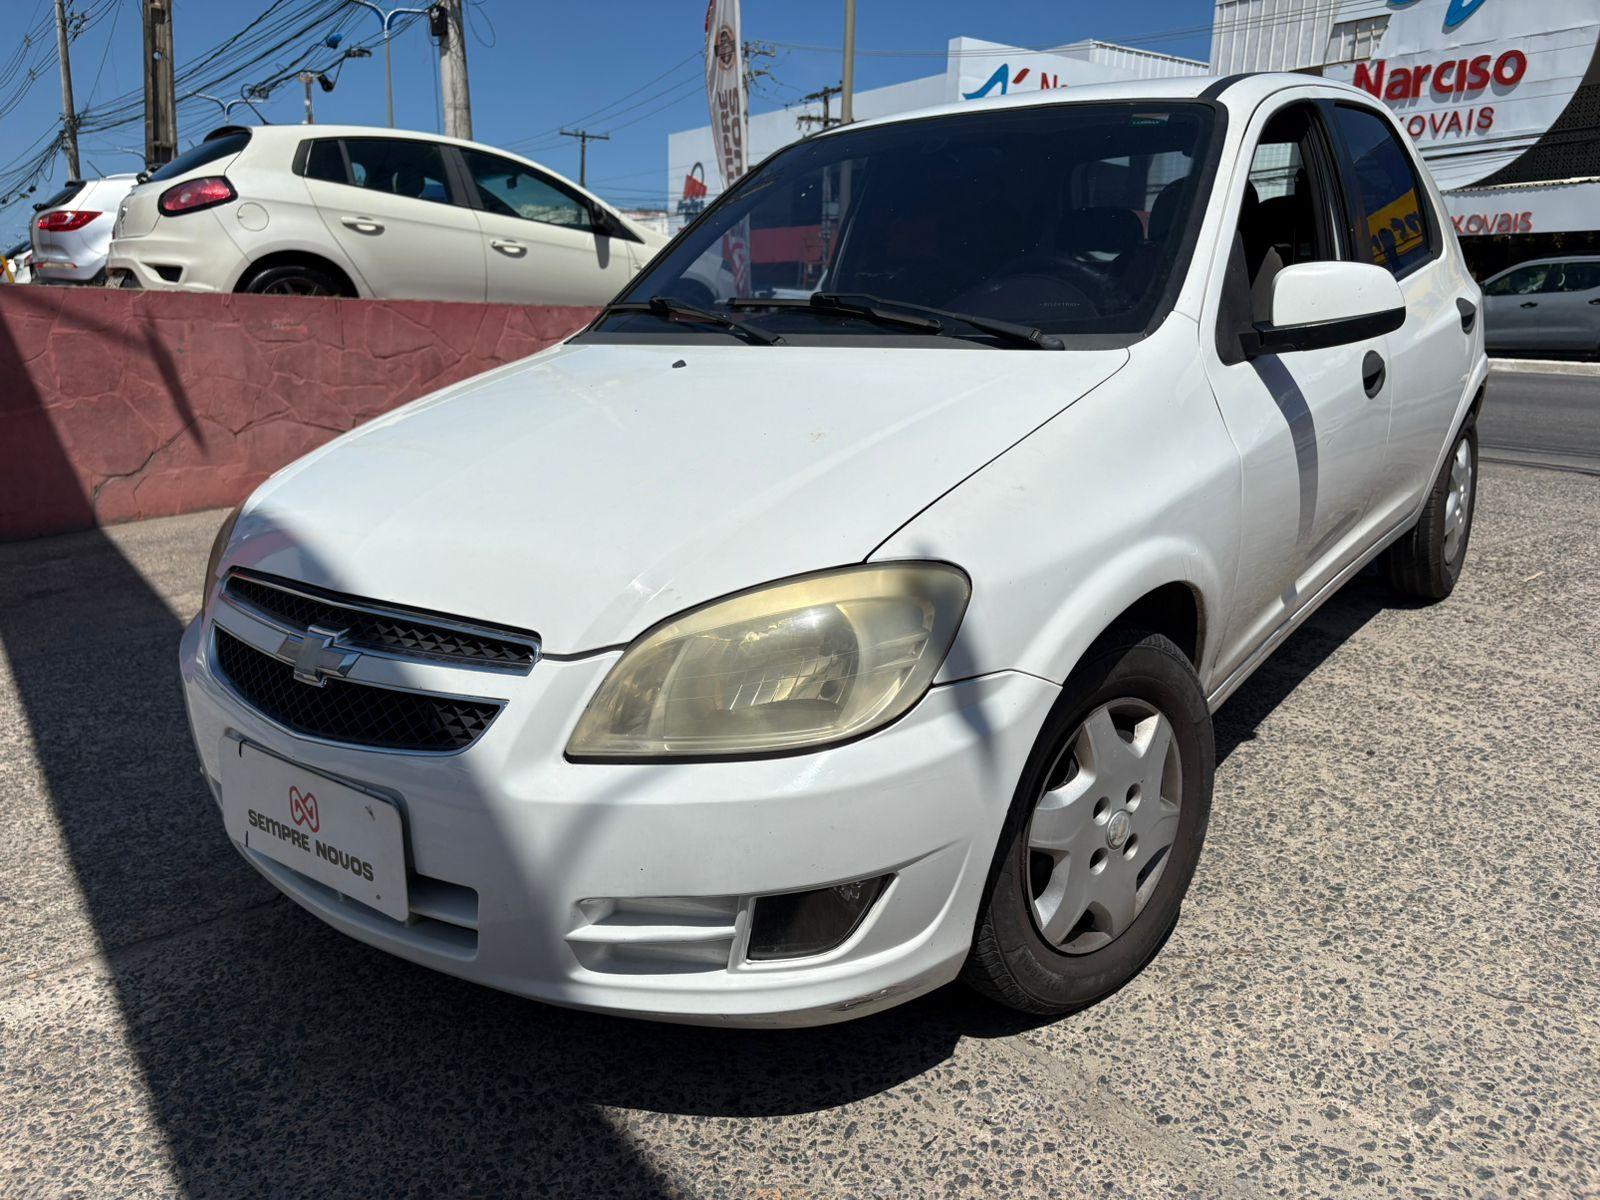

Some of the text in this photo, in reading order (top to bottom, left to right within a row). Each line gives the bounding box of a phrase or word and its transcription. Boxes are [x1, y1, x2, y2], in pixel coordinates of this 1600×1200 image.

[1353, 49, 1527, 100] Narciso
[1400, 106, 1494, 136] OVAIS
[248, 808, 311, 852] SEMPRE
